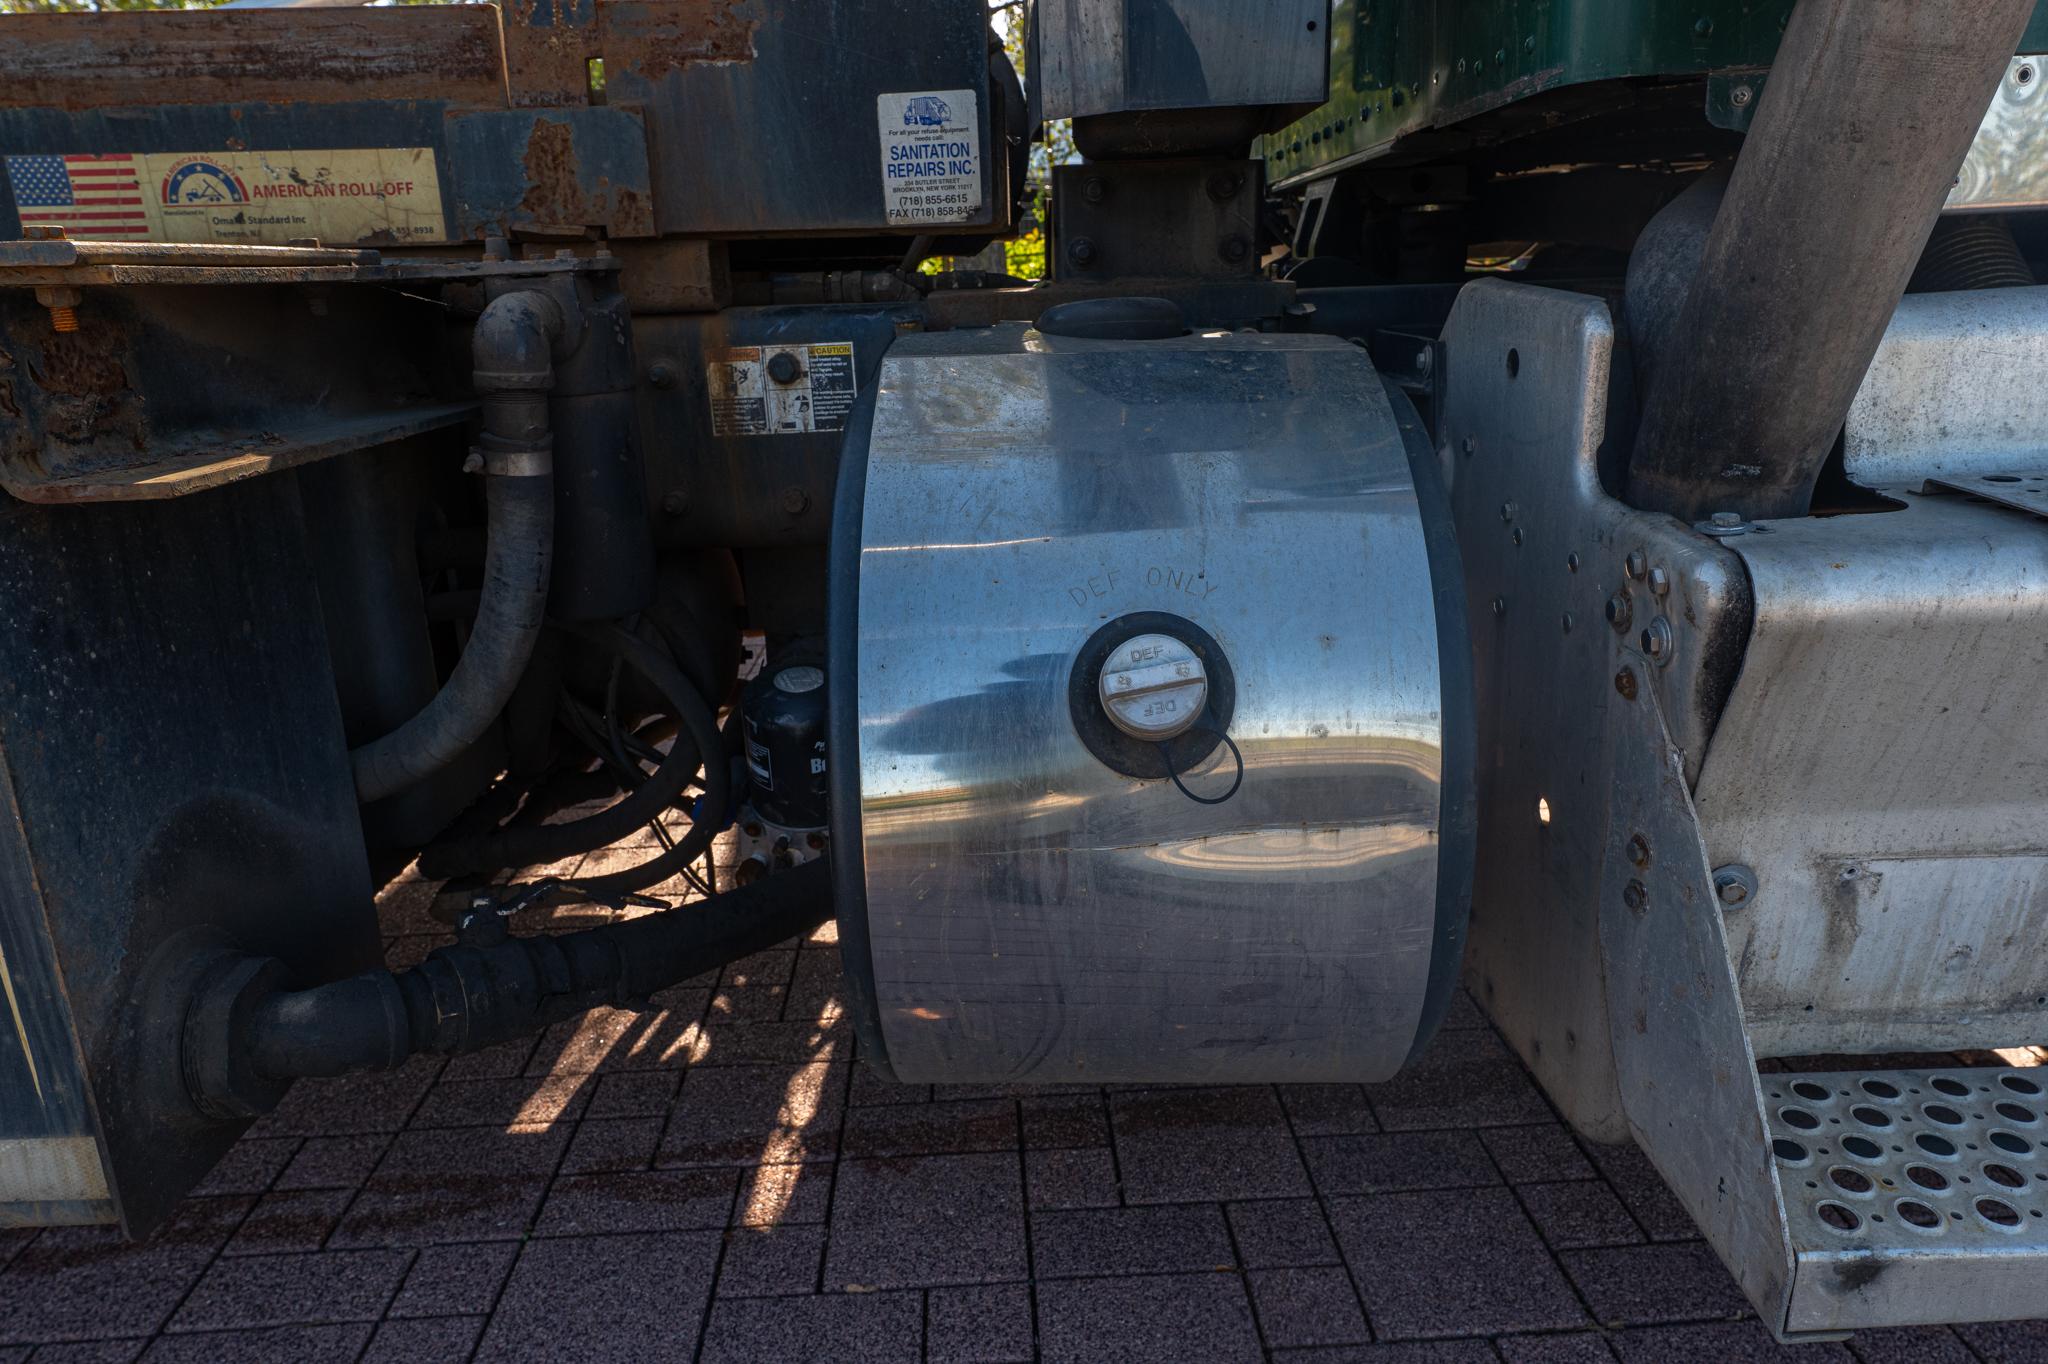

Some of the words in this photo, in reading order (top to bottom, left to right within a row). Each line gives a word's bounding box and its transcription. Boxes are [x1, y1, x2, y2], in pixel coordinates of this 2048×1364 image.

[890, 142, 970, 160] SANITATION
[888, 162, 946, 178] REPAIRS
[949, 160, 976, 176] INC.
[253, 182, 335, 198] AMERICAN
[900, 196, 922, 206] (718)
[925, 194, 968, 204] 855-6615
[212, 216, 246, 224] Oma
[248, 215, 290, 224] Standard
[889, 208, 908, 218] FAX
[912, 208, 934, 219] (718)
[1068, 568, 1121, 608] DEF
[1146, 566, 1219, 601] ONLY
[1130, 644, 1164, 664] DEF
[1144, 699, 1177, 718] DEF
